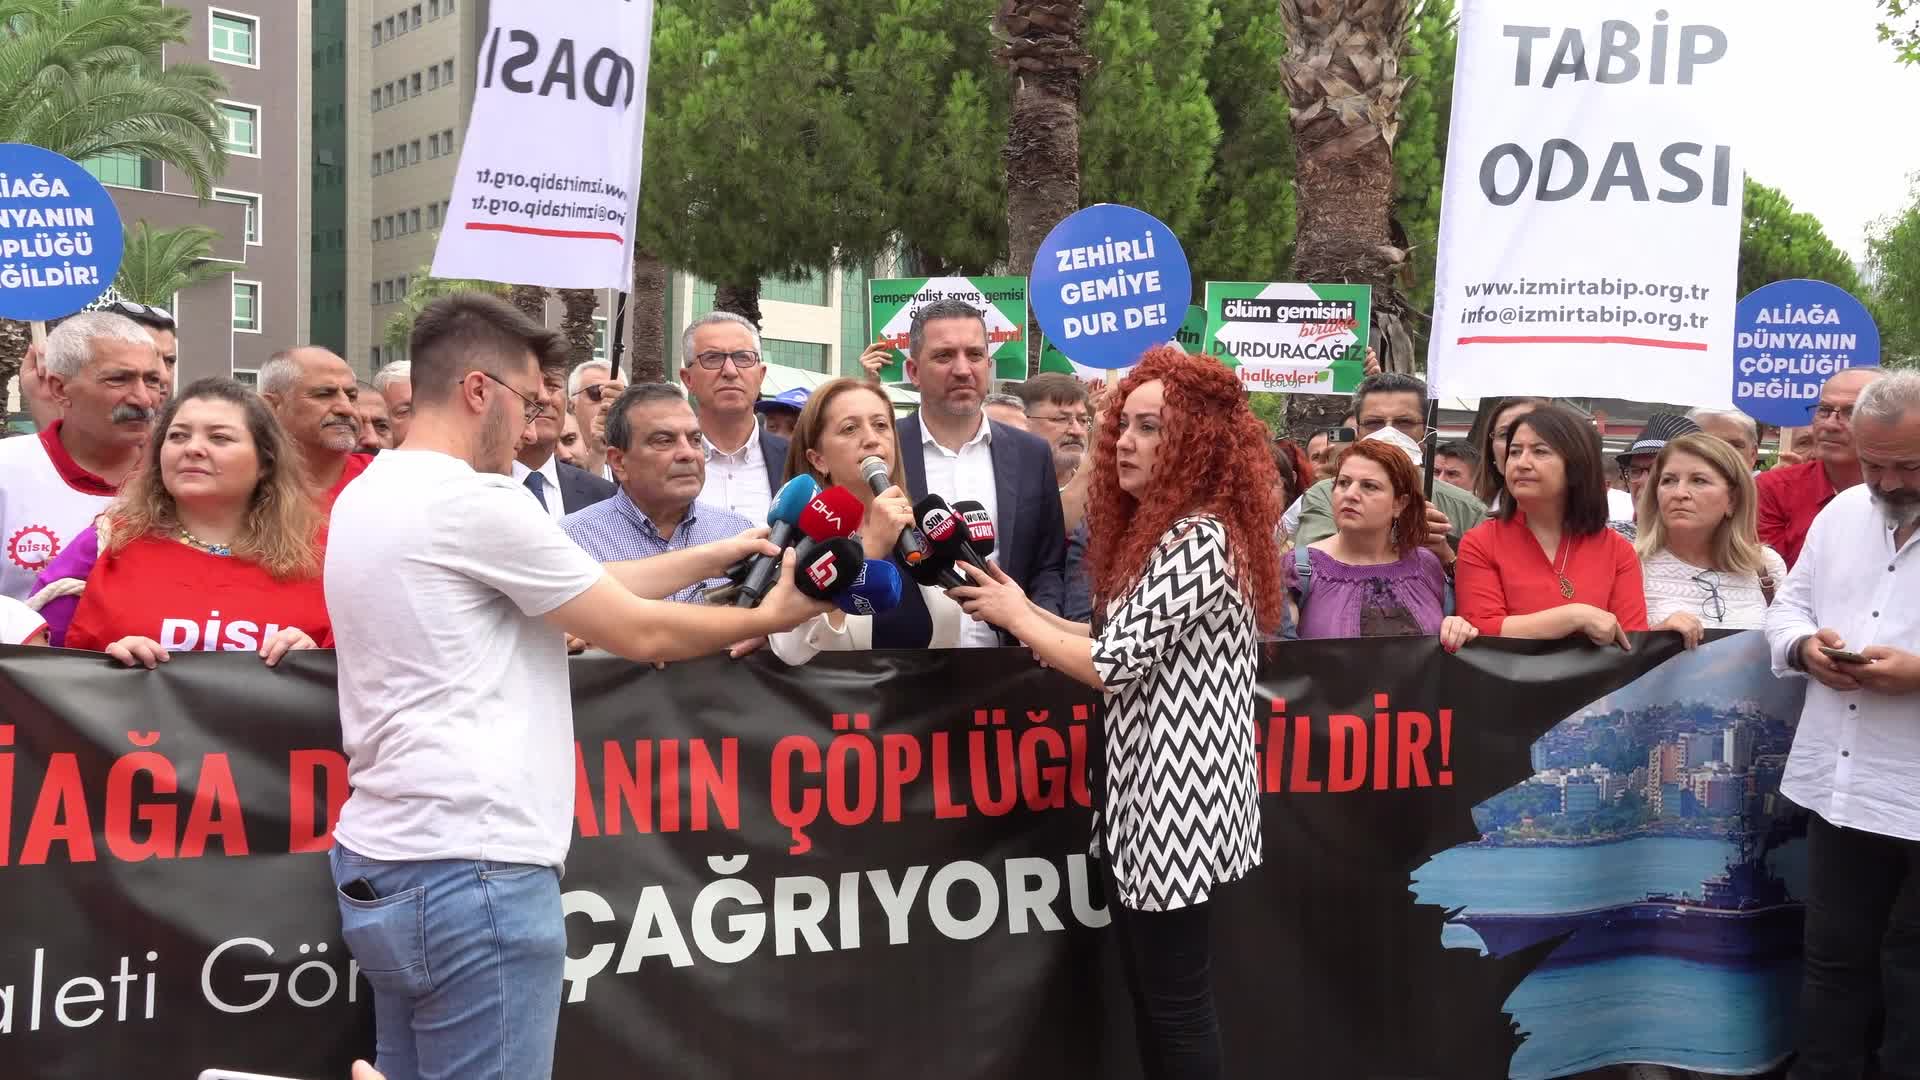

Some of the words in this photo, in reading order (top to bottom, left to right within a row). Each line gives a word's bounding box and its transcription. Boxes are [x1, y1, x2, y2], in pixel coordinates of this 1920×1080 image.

[1503, 9, 1728, 89] TABİP
[1479, 138, 1730, 206] ODASI
[0, 172, 70, 198] İAĞA
[0, 232, 93, 258] PLÜĞÜ
[1056, 230, 1155, 272] ZEHİRLİ
[0, 261, 99, 289] ĞİLDİR!
[1060, 268, 1161, 305] GEMİYE
[873, 289, 943, 305] emperyalist
[947, 291, 980, 305] savaş
[985, 288, 1024, 303] gemisi
[1464, 277, 1710, 302] www.izmirtabip.org.tr
[1063, 311, 1119, 339] DUR
[1124, 303, 1168, 330] DE!
[1224, 300, 1271, 318] ölüm
[1276, 301, 1353, 323] gemisini
[1460, 305, 1709, 331] info@izmirtabip.org.tr
[1755, 303, 1840, 325] ALİAĞA
[1213, 339, 1364, 361] DURDURACAĞIZ
[1737, 328, 1857, 350] DÜNYANIN
[1240, 368, 1319, 384] halkevleri
[1739, 353, 1850, 377] ÇÖPLÜĞÜ
[925, 512, 944, 530] SON
[969, 524, 994, 538] TÜRK
